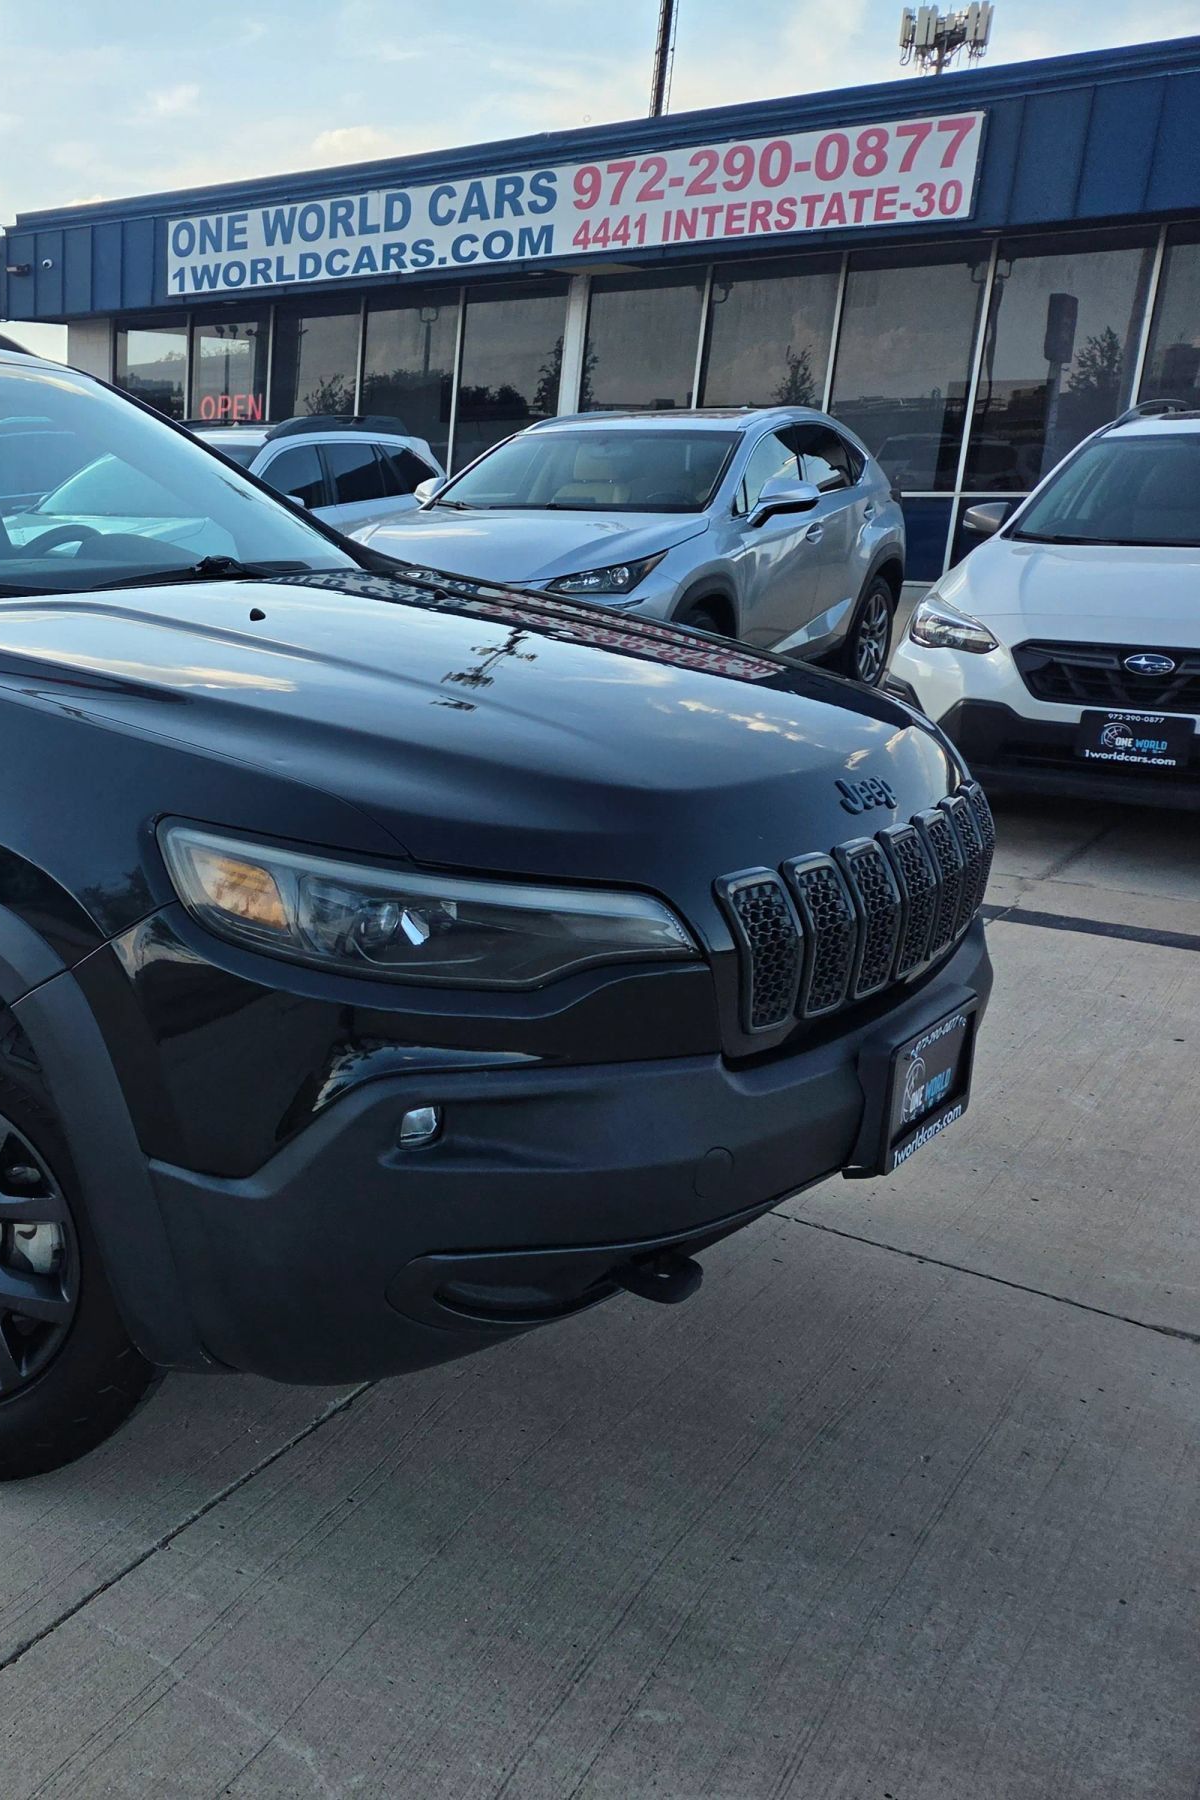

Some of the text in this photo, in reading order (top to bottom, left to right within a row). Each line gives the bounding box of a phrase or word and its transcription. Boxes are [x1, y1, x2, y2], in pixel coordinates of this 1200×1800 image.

[572, 116, 977, 211] 972-290-0877
[171, 170, 558, 258] ONE WORLD CARS
[572, 179, 963, 251] 4441 INTERSTATE-30
[171, 224, 555, 293] 1WORLDCARS.COM
[200, 393, 263, 420] OPEN
[1108, 713, 1164, 723] 972-290-0877
[1115, 737, 1168, 750] ONE WORLD
[1084, 749, 1177, 766] 1worldcars.com
[834, 776, 897, 815] Jeep
[893, 1103, 962, 1169] 1worldcars.com
